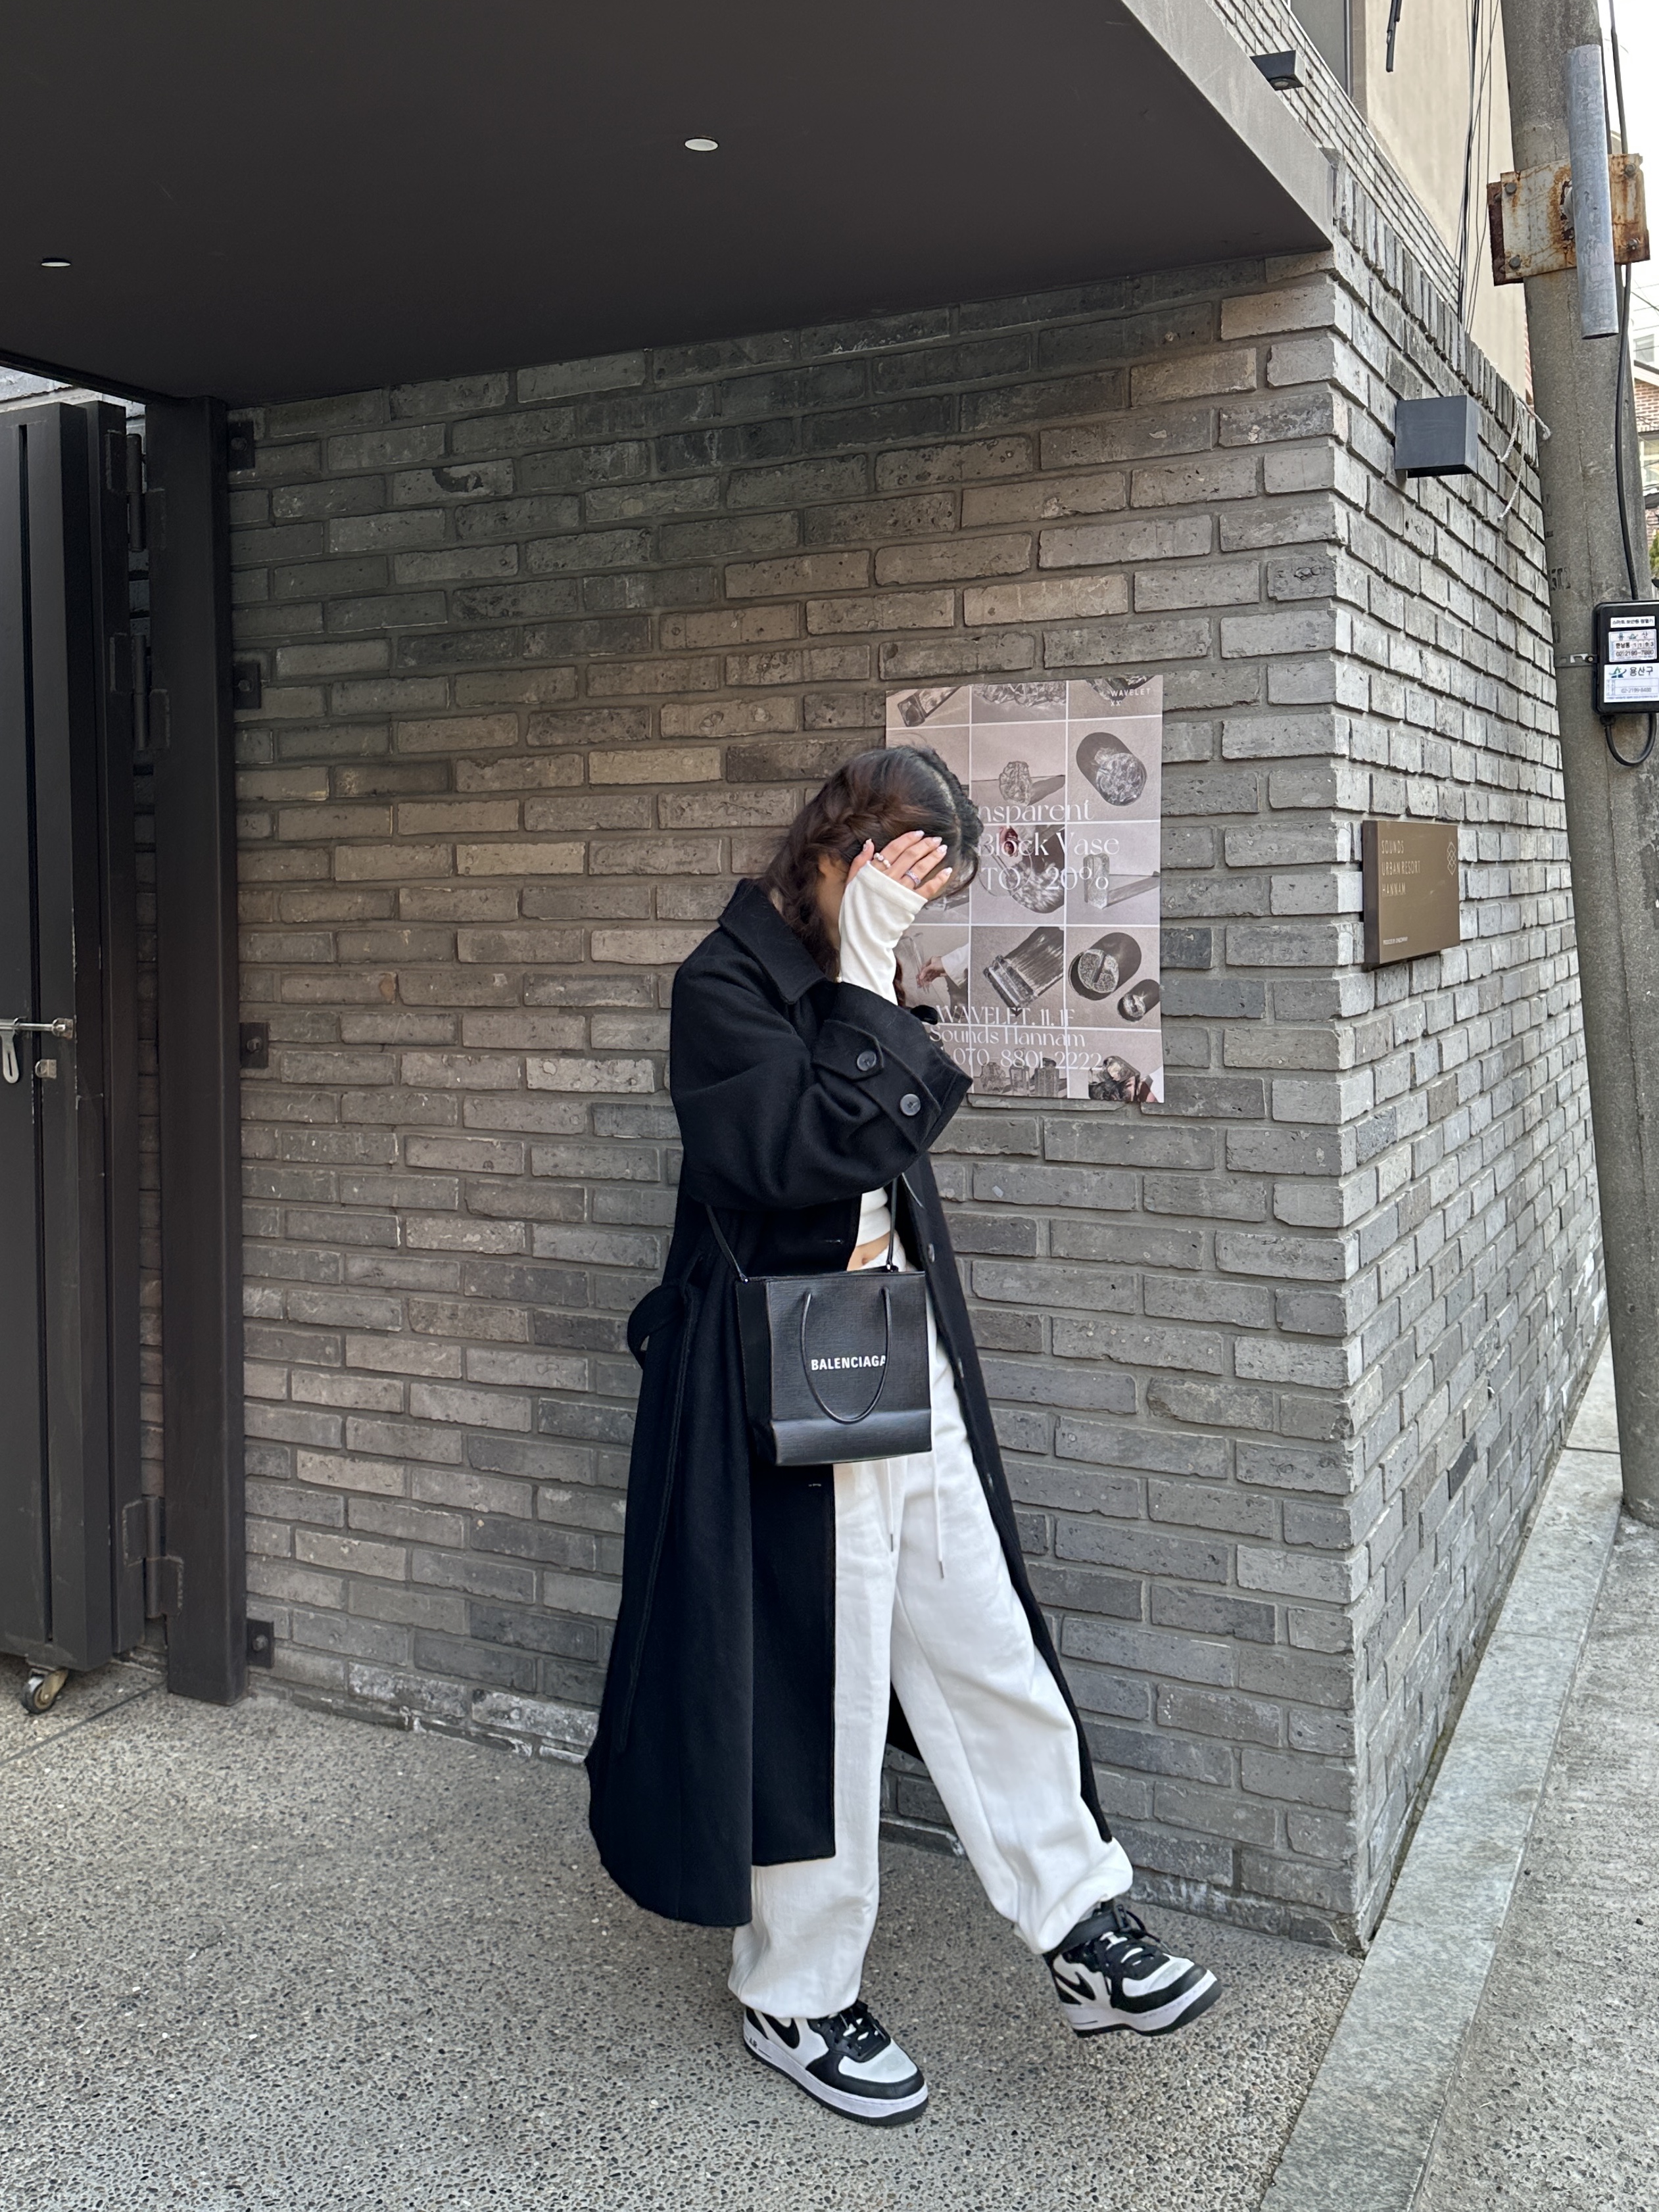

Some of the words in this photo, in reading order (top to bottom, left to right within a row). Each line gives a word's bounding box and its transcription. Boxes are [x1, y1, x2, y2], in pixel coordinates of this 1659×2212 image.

[1630, 666, 1653, 677] 용산구
[1111, 688, 1151, 696] WAVELET
[978, 800, 1095, 829] nsparent
[978, 832, 1049, 856] Block
[1056, 832, 1120, 855] Vase
[1382, 840, 1405, 854] SOUNDS
[1382, 861, 1401, 876] URBAN
[1401, 860, 1420, 875] RESORT
[981, 867, 1021, 890] TO
[1045, 866, 1109, 890] 20%
[1382, 882, 1406, 897] HANNAM
[929, 1025, 999, 1045] Sounds
[1005, 1026, 1086, 1047] Hannam
[811, 1355, 886, 1371] BALENCIAGA
